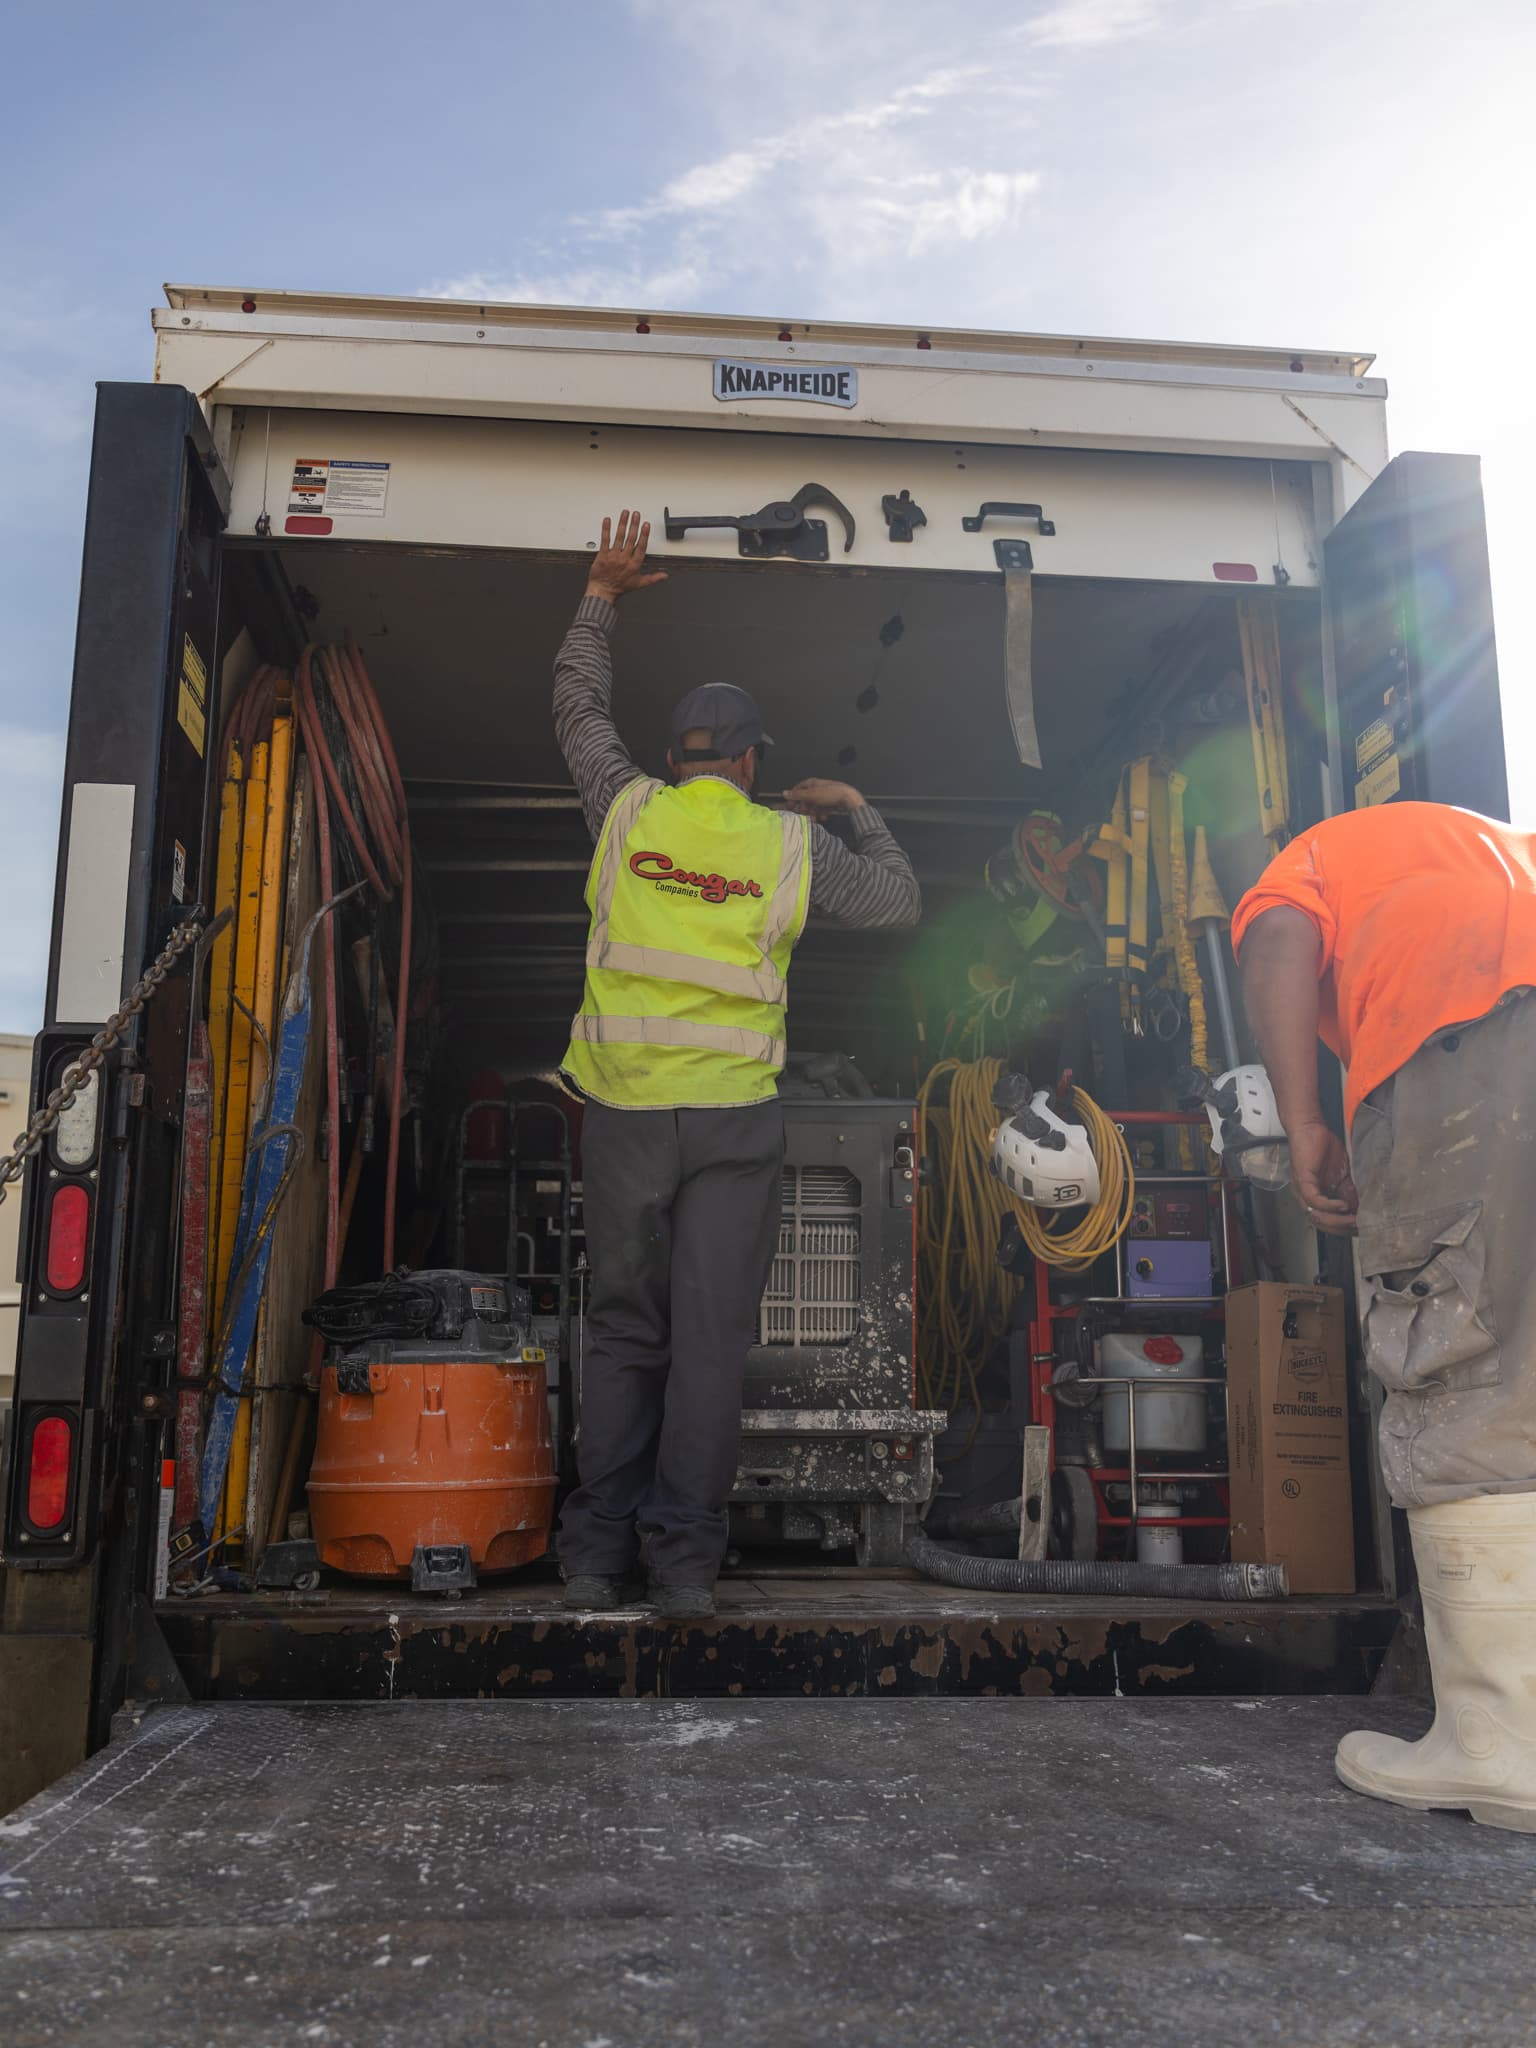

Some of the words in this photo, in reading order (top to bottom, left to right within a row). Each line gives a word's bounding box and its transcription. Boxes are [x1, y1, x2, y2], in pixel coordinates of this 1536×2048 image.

[721, 364, 850, 401] KNAPHEIDE
[629, 851, 764, 904] Cougar
[655, 880, 699, 898] Companies
[1297, 1391, 1319, 1404] FIRE
[1272, 1403, 1343, 1418] EXTINGUISHER
